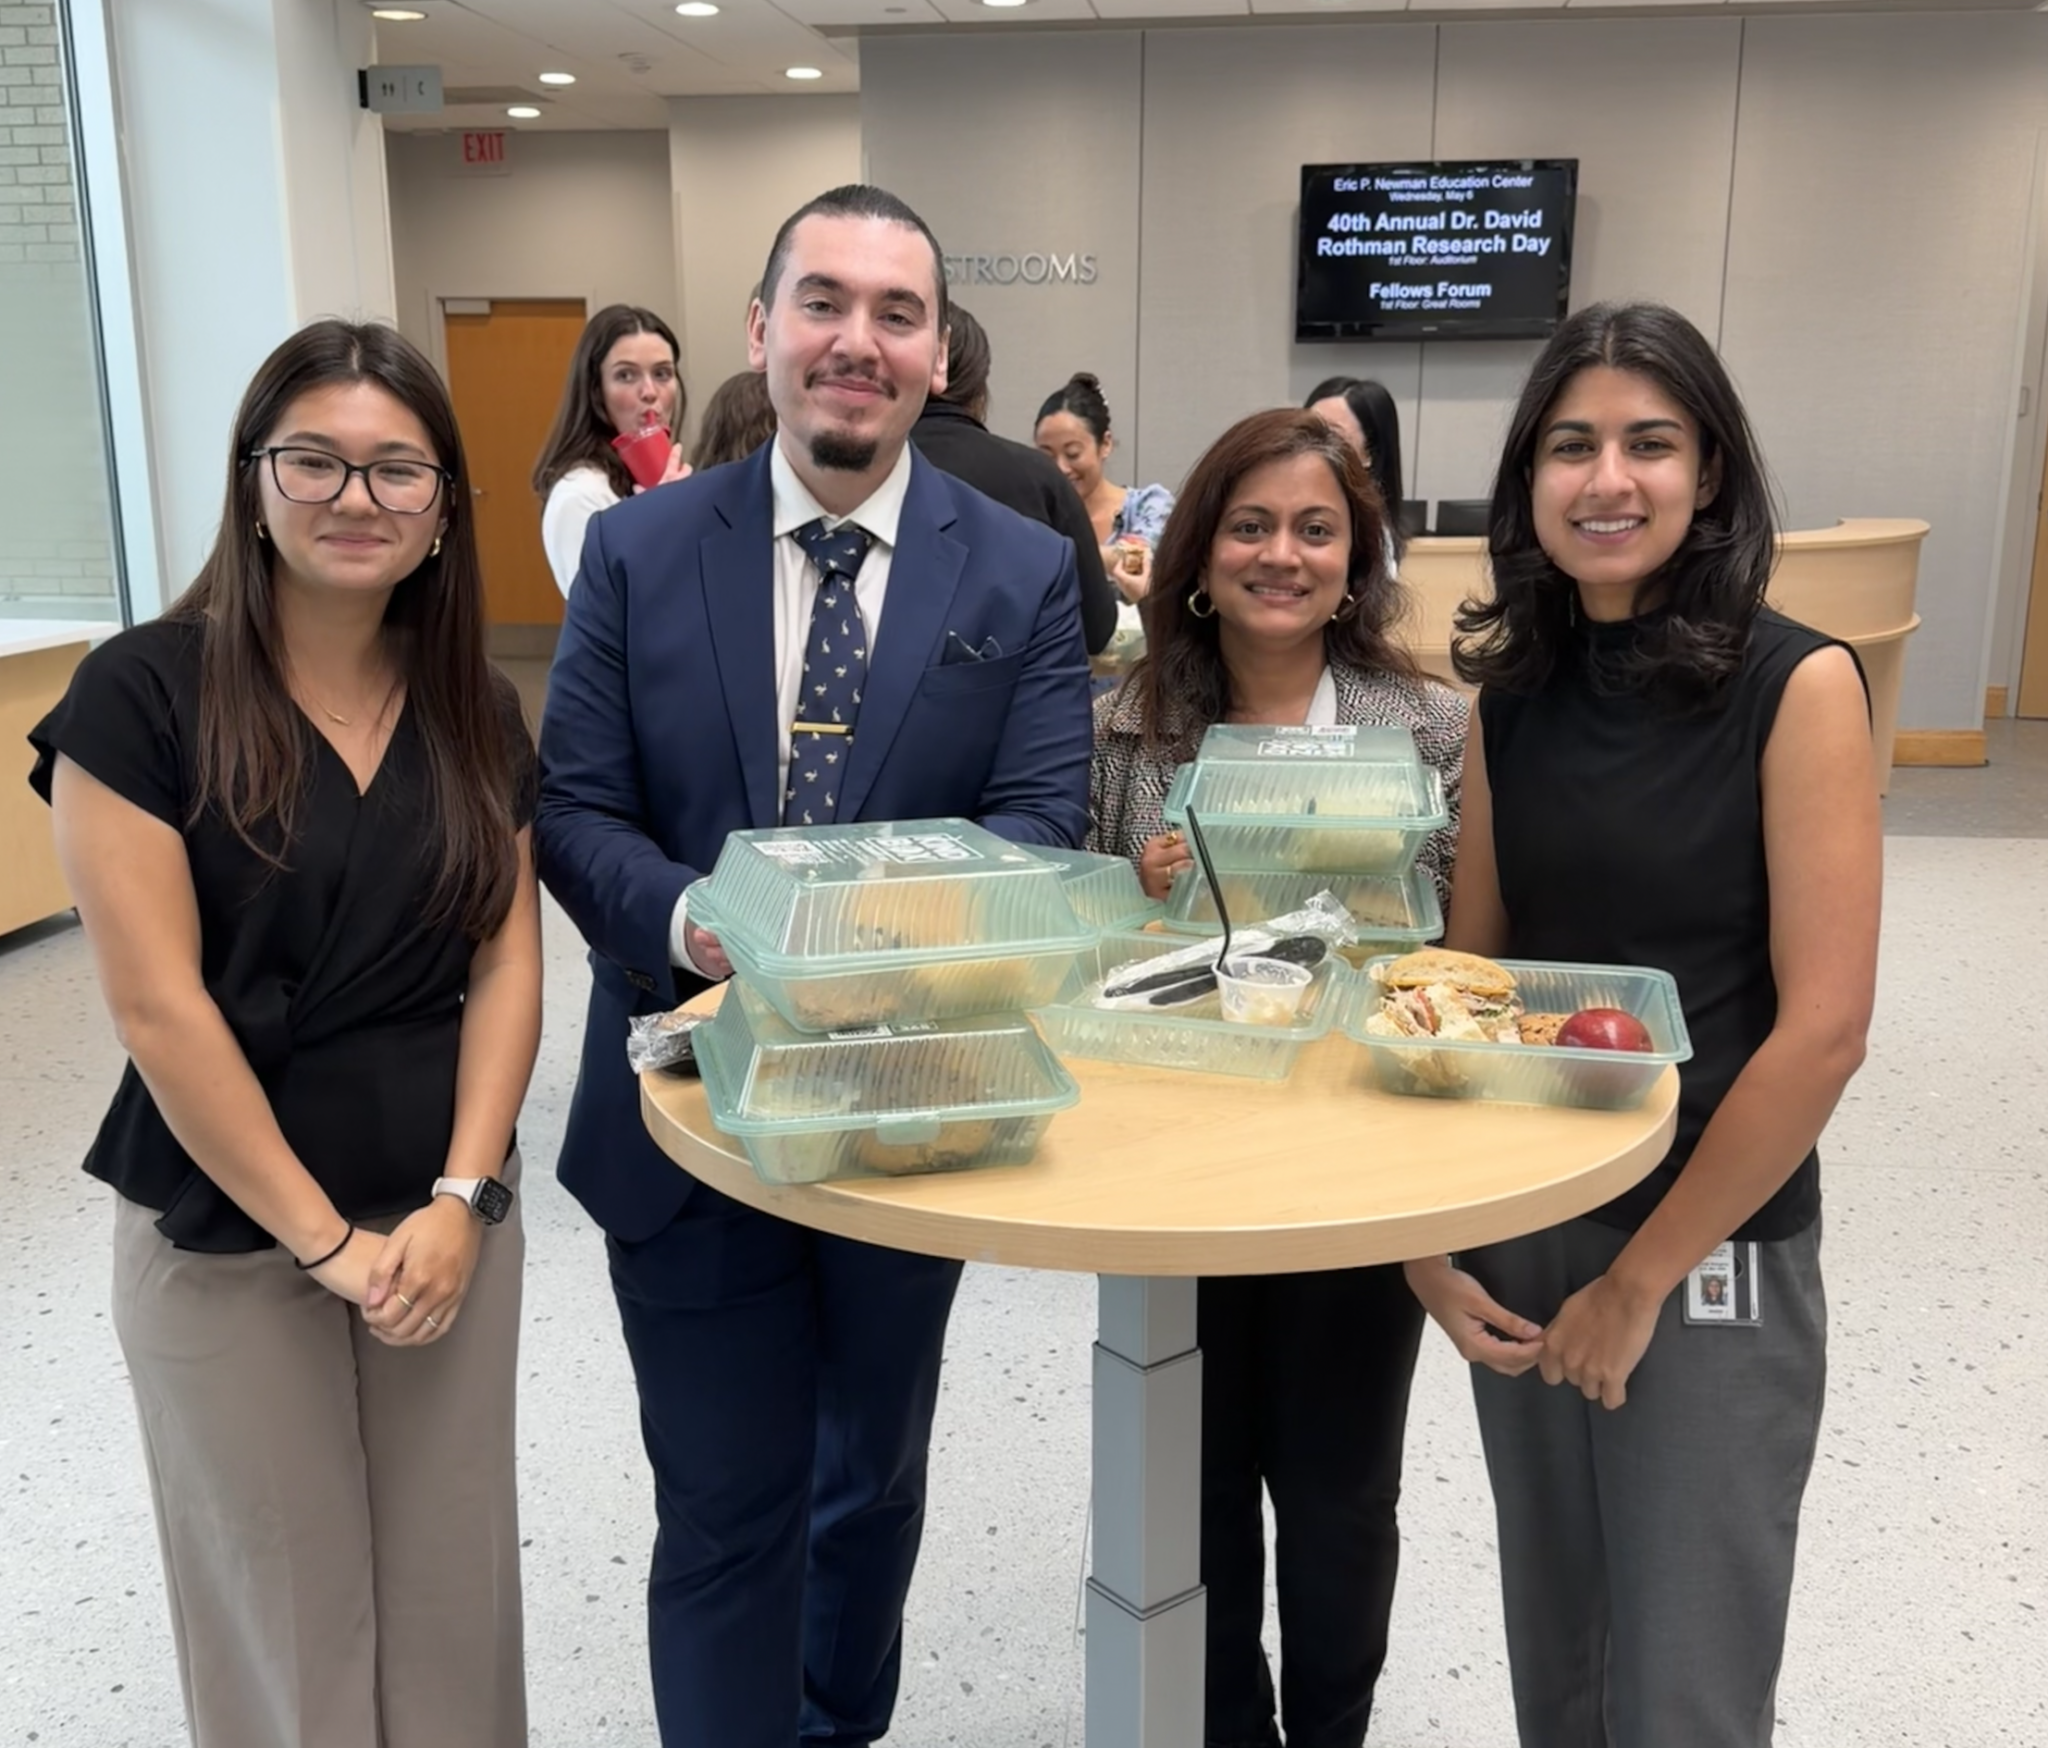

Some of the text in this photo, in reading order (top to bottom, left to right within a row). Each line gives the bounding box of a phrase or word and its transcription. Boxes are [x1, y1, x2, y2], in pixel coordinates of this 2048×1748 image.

[464, 132, 505, 162] EXIT
[1333, 174, 1534, 191] Eric P. Newman Education Center
[1445, 190, 1465, 202] May
[1327, 208, 1543, 232] 40th Annual Dr. David
[1317, 233, 1551, 256] Rothman Research Day
[943, 252, 1098, 284] STROOMS
[1388, 256, 1402, 266] 1st
[1429, 255, 1478, 265] Auditorium
[1369, 281, 1492, 299] Fellows Forum
[1380, 300, 1394, 310] 1st
[1421, 299, 1447, 310] Great
[1448, 299, 1481, 309] Rooms
